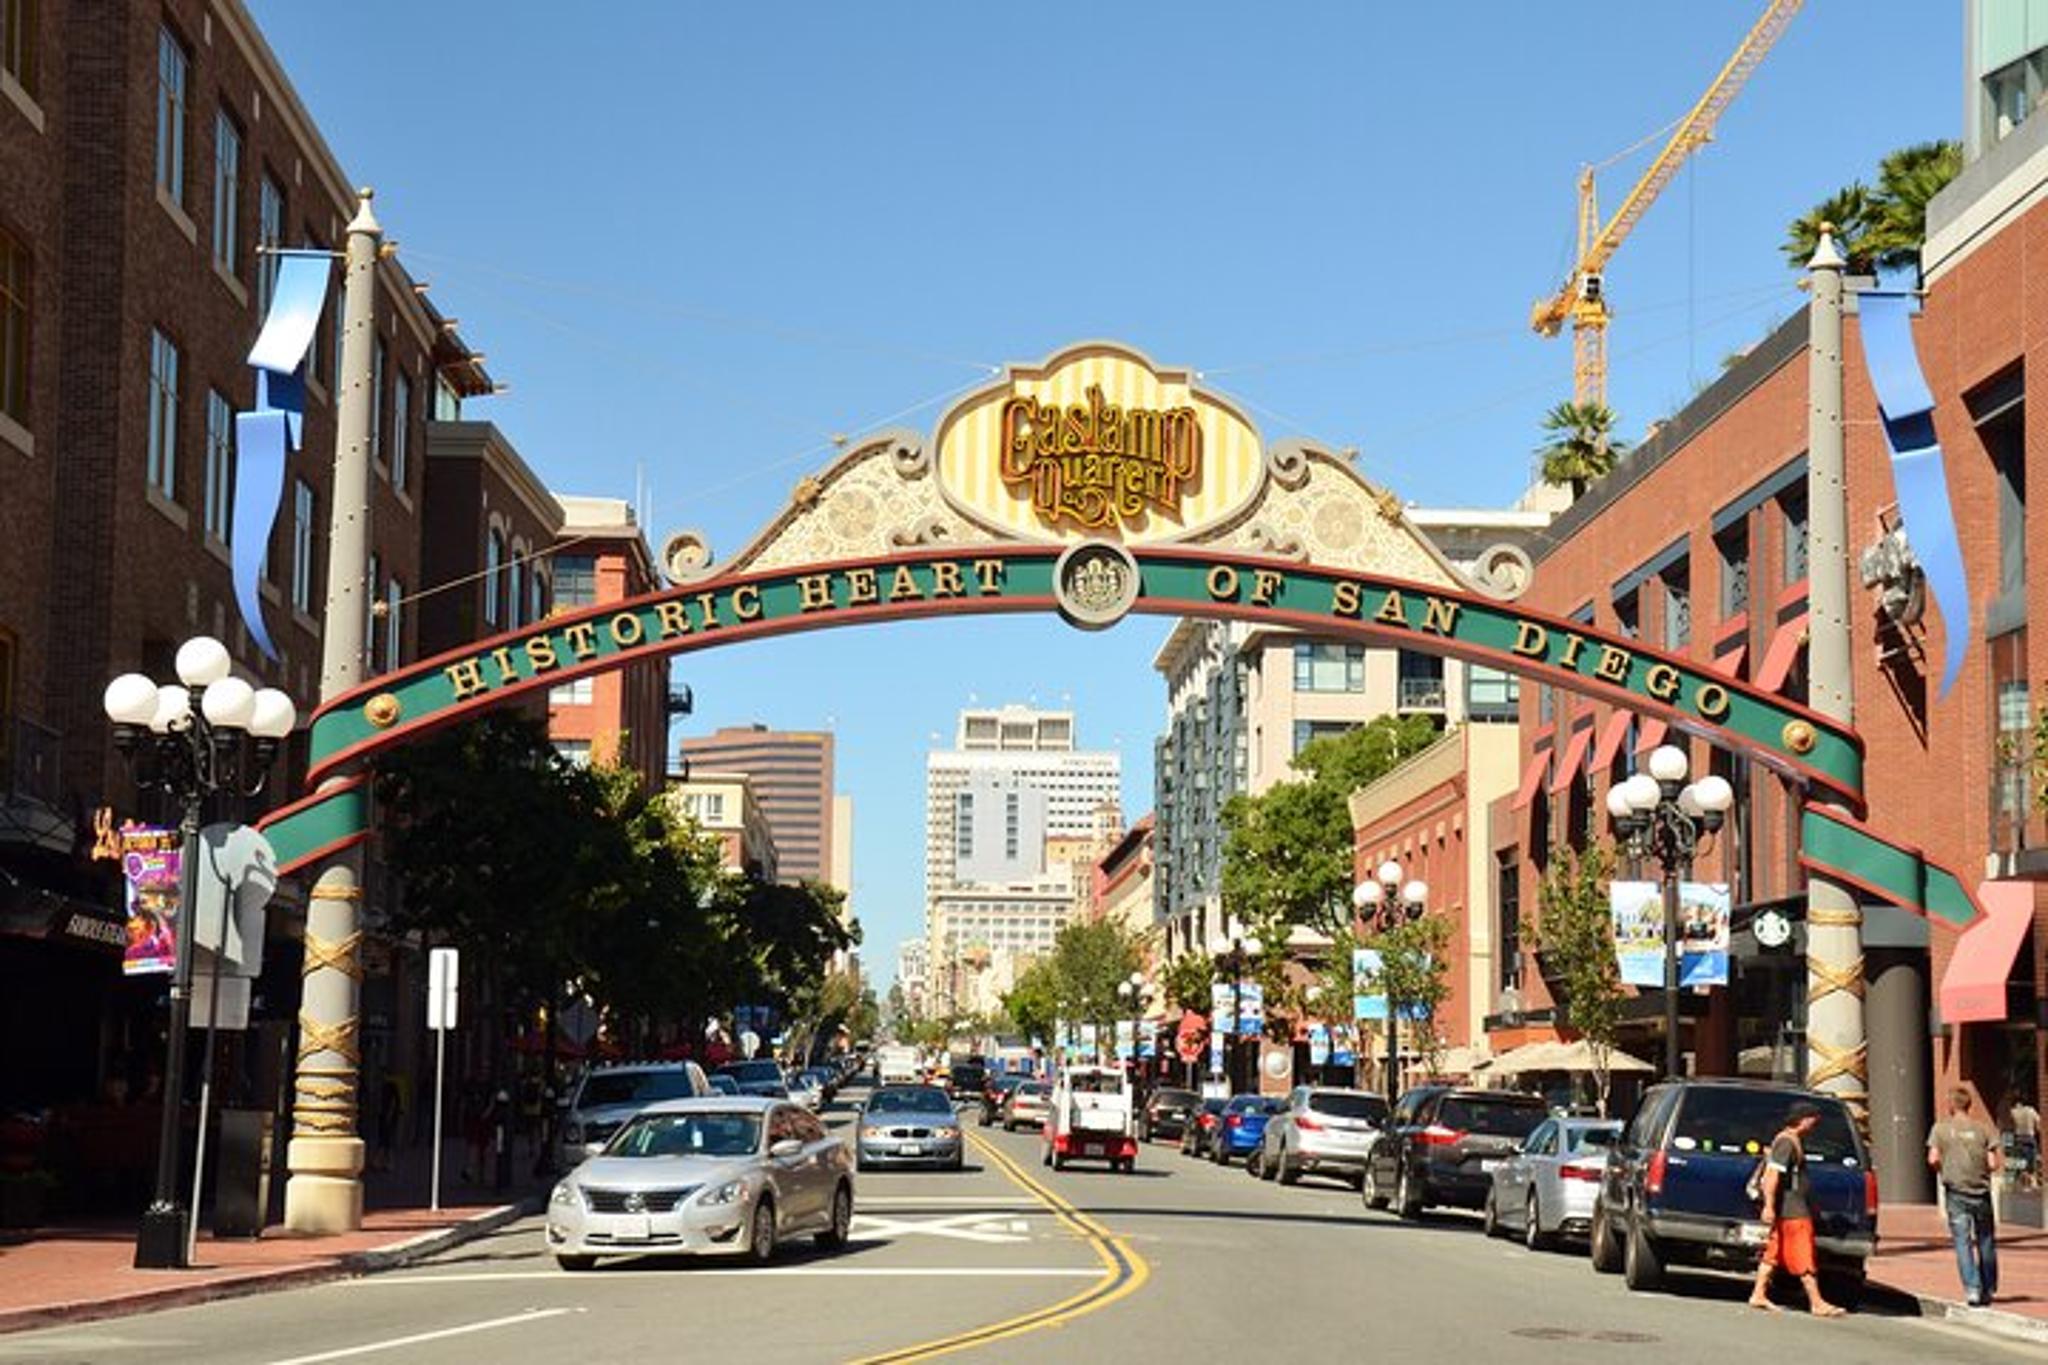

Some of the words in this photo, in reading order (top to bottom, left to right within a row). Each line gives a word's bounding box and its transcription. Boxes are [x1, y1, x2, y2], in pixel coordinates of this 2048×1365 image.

[1001, 382, 1198, 507] Gaslamp
[1034, 453, 1166, 527] Quarter
[445, 586, 761, 696] HISTORIC
[797, 560, 1003, 609] HEART
[1206, 565, 1284, 603] OF
[1332, 582, 1460, 632] SAN
[1510, 620, 1729, 716] DIEGO
